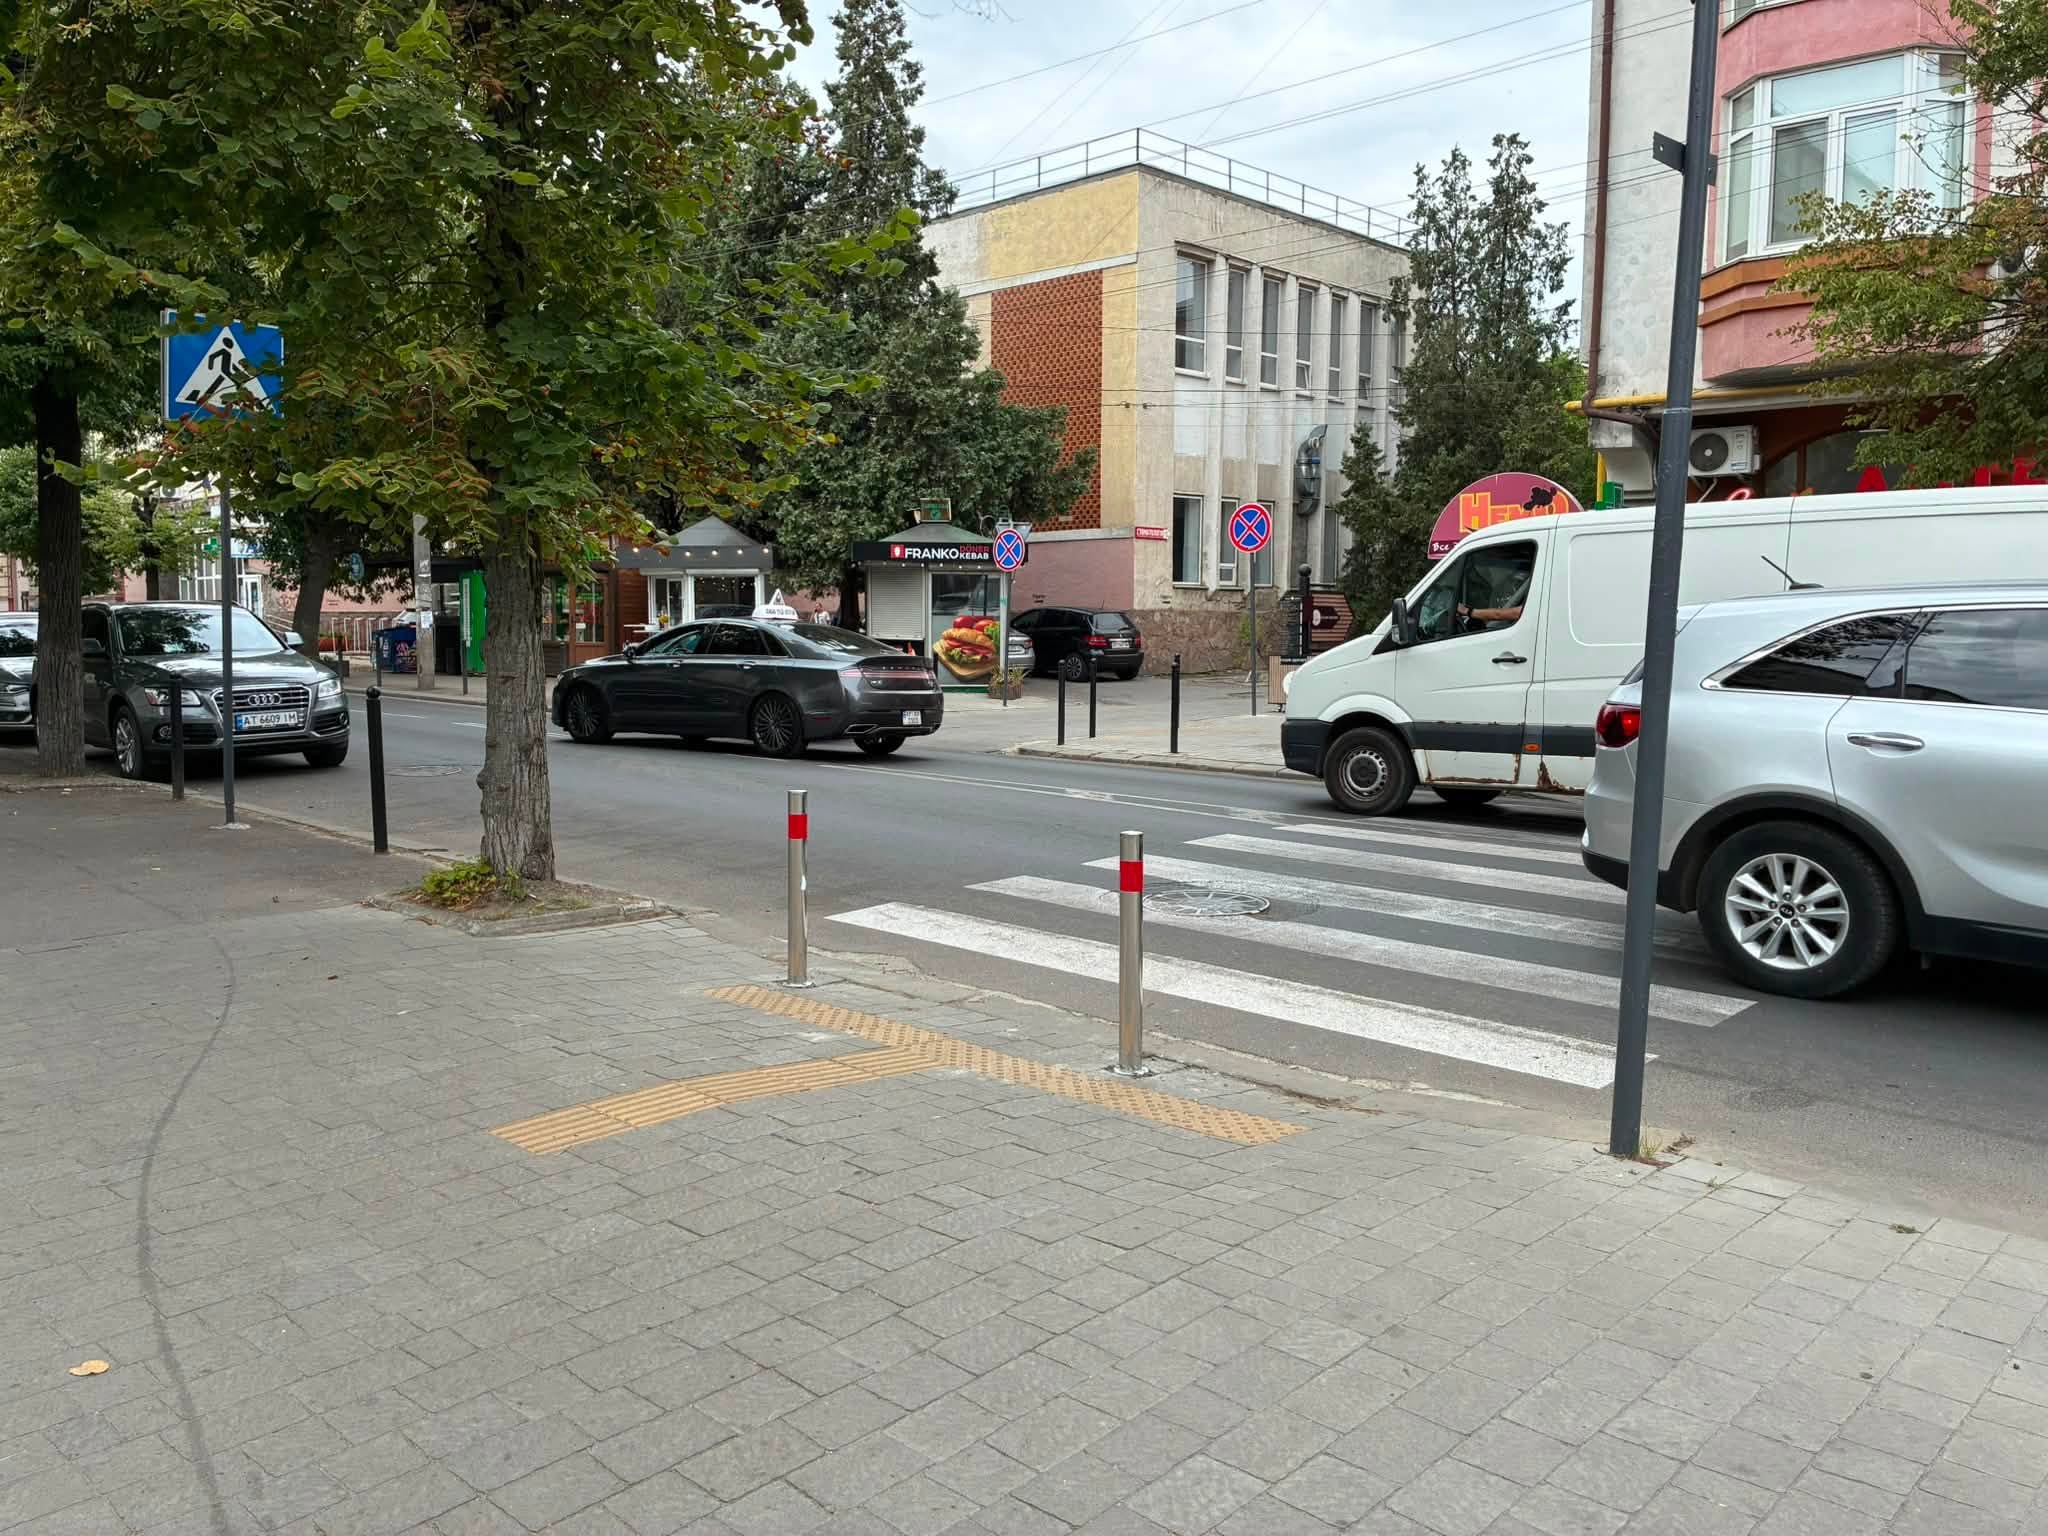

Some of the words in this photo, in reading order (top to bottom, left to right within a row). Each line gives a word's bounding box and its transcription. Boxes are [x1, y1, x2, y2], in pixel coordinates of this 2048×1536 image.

[960, 545, 990, 553] DÖNER
[1432, 542, 1450, 552] Все
[905, 548, 960, 559] FRANKO
[244, 715, 257, 725] AT
[259, 714, 281, 724] 6609
